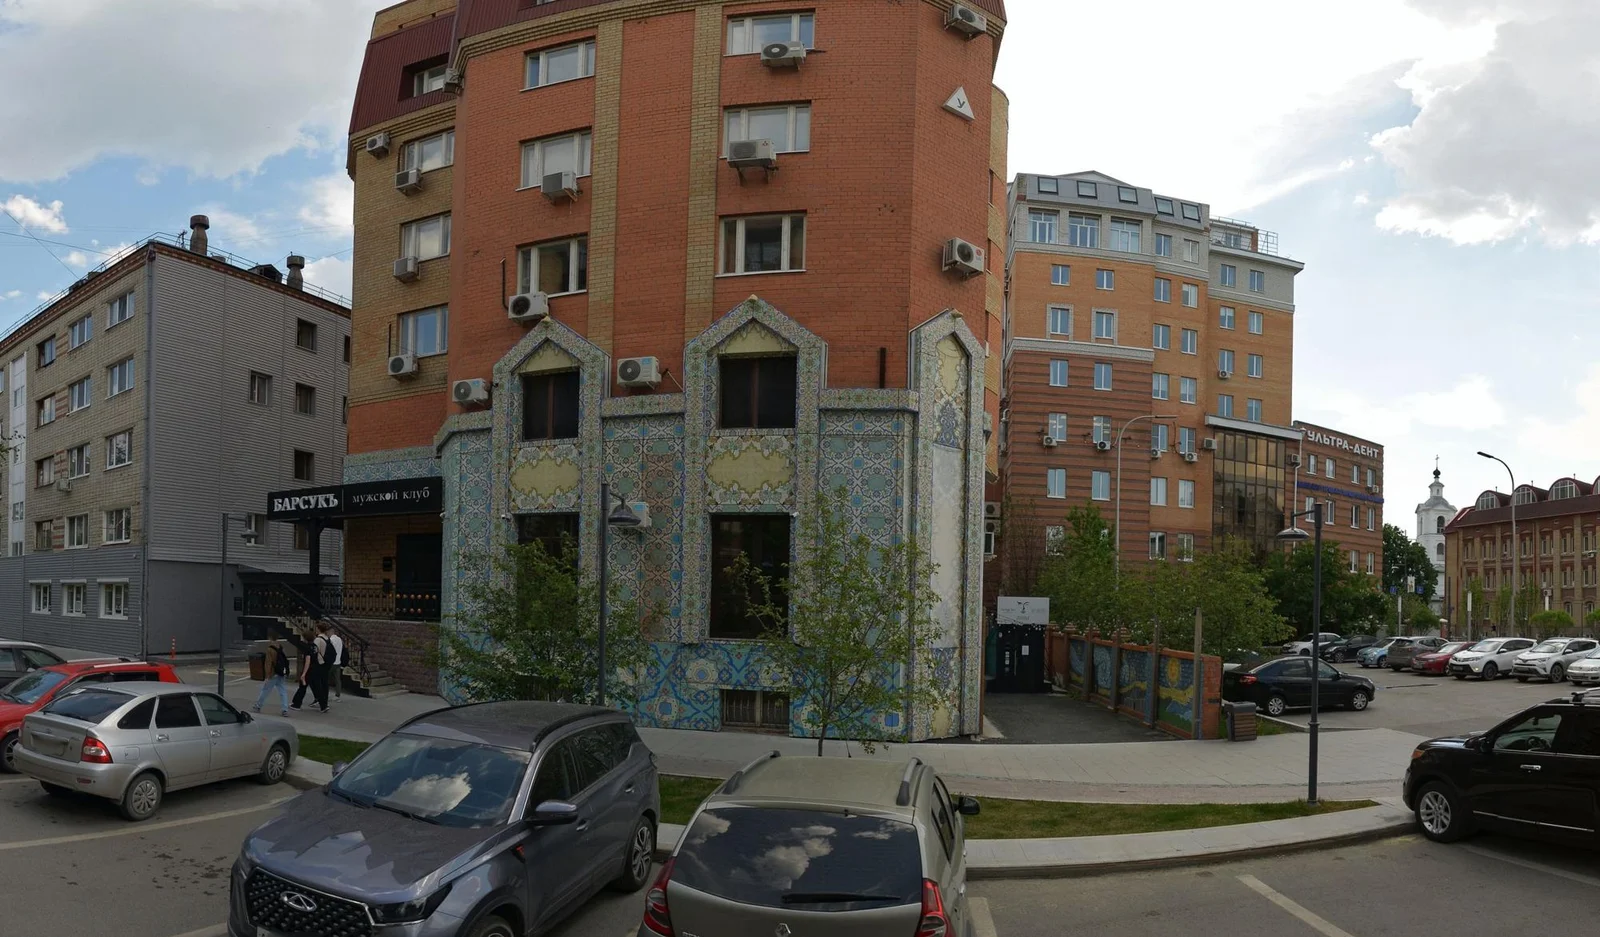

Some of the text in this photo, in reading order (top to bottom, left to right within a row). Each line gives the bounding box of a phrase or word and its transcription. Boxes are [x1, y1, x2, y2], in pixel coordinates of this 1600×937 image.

[1307, 430, 1379, 459] УЛЬТРА-ДЕНТ
[273, 493, 339, 512] БАРСУКЪ
[352, 486, 430, 506] мужской клуб
